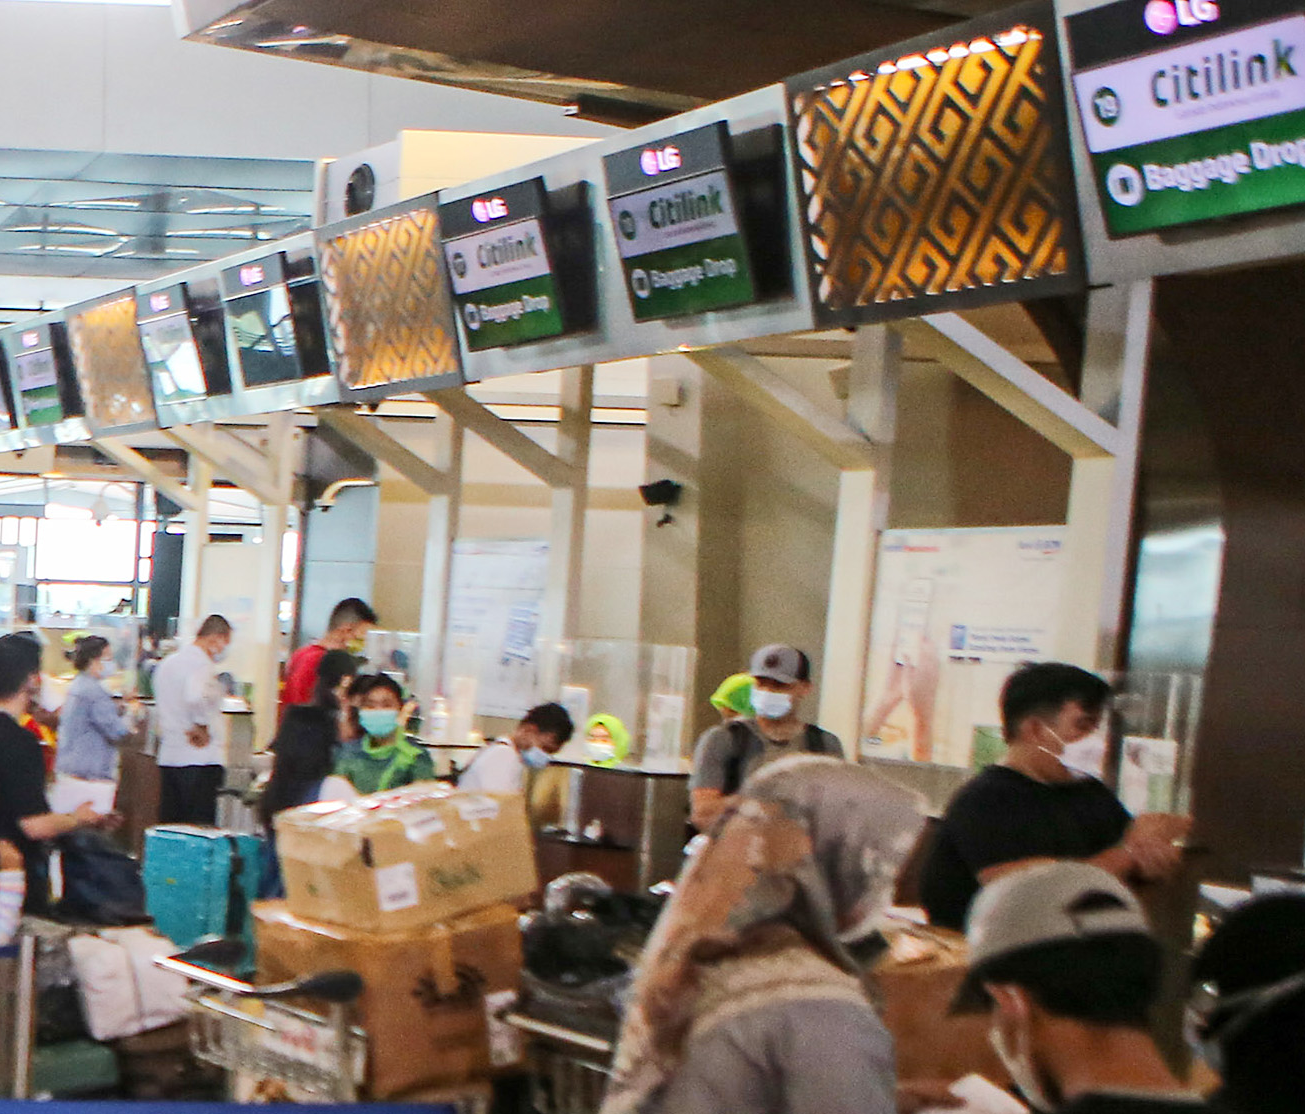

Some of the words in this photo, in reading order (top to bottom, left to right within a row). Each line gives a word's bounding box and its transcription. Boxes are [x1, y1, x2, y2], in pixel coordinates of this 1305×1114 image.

[1174, 0, 1220, 26] LG
[1150, 38, 1298, 108] Citilink
[655, 145, 682, 172] LG
[1142, 151, 1252, 192] Baggage
